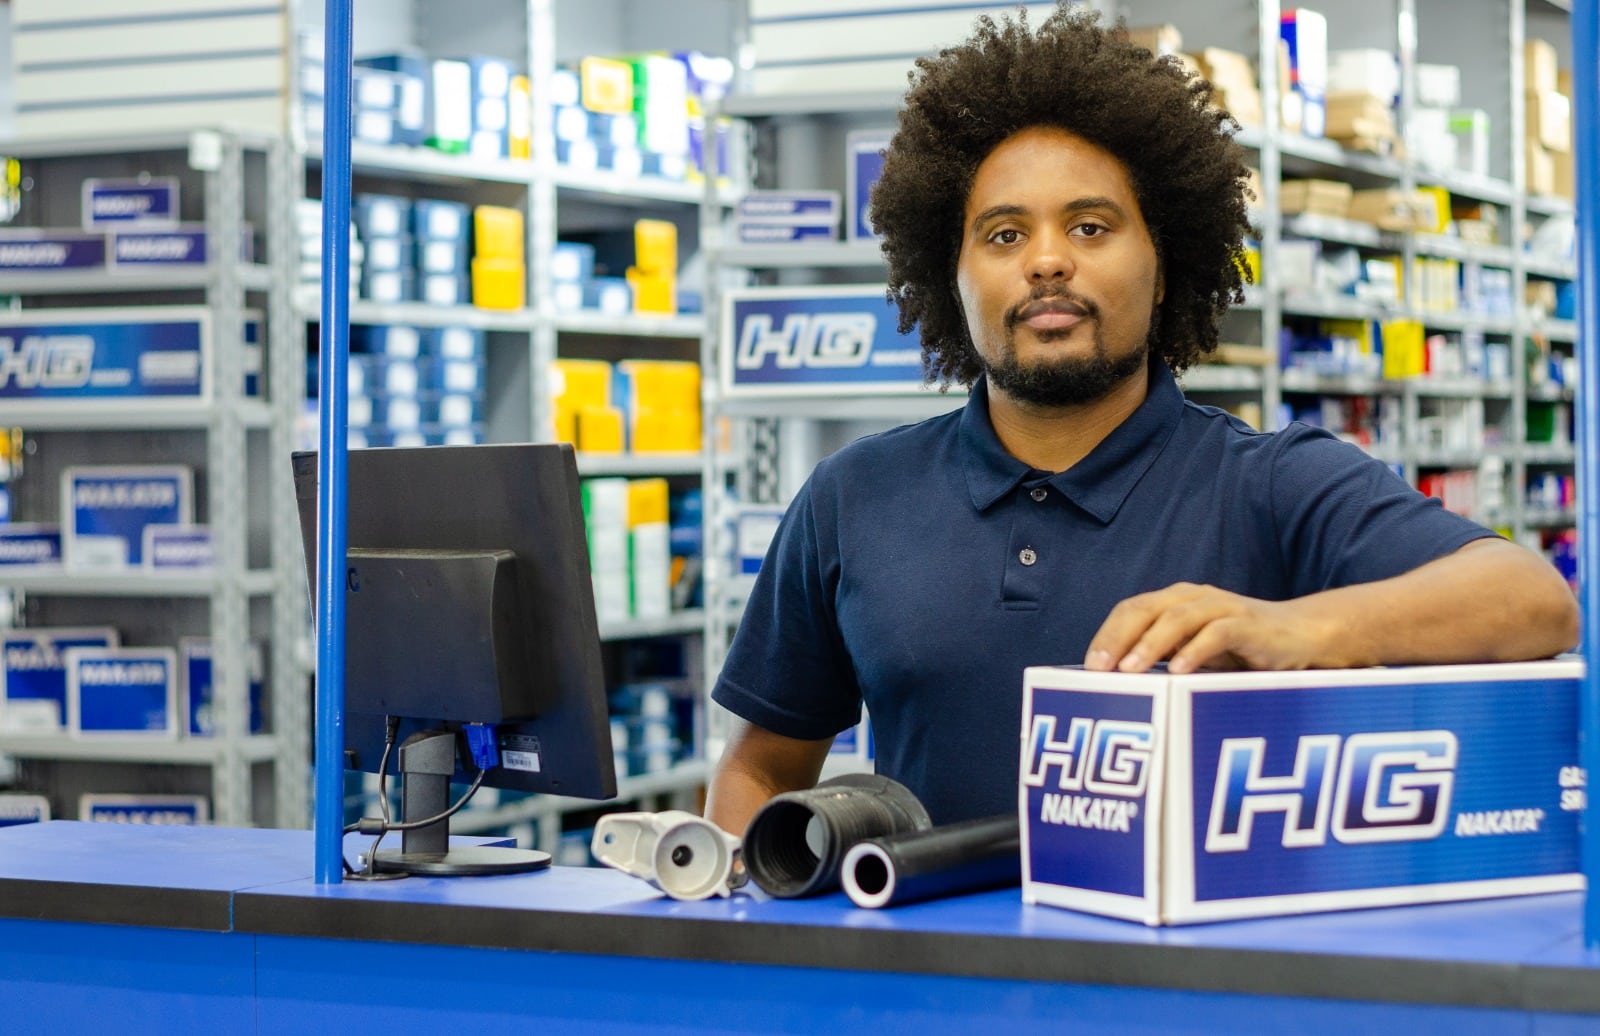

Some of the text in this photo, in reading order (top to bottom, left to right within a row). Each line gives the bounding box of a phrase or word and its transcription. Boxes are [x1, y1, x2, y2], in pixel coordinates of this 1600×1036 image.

[737, 313, 876, 370] HG
[80, 661, 165, 685] NAKATA
[1025, 714, 1155, 797] HG
[1205, 730, 1458, 853] HG
